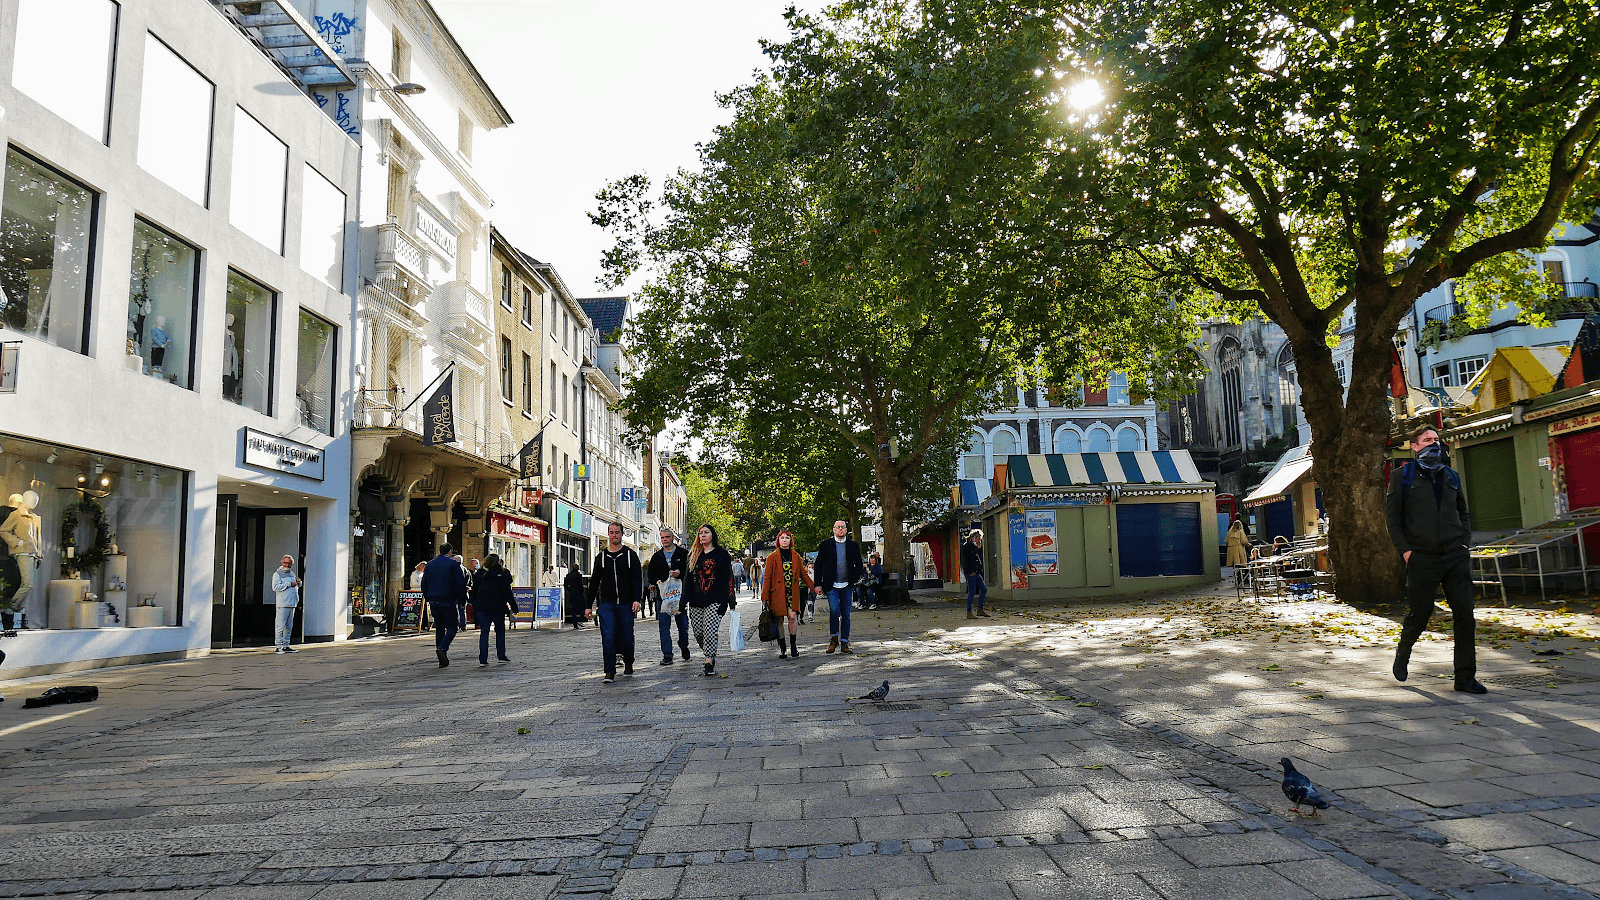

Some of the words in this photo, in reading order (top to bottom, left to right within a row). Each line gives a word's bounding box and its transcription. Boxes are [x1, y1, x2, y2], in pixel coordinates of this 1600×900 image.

[430, 414, 444, 442] Royal
[438, 395, 452, 438] Arcade
[268, 442, 289, 455] WHITE
[291, 449, 320, 463] COMPANY
